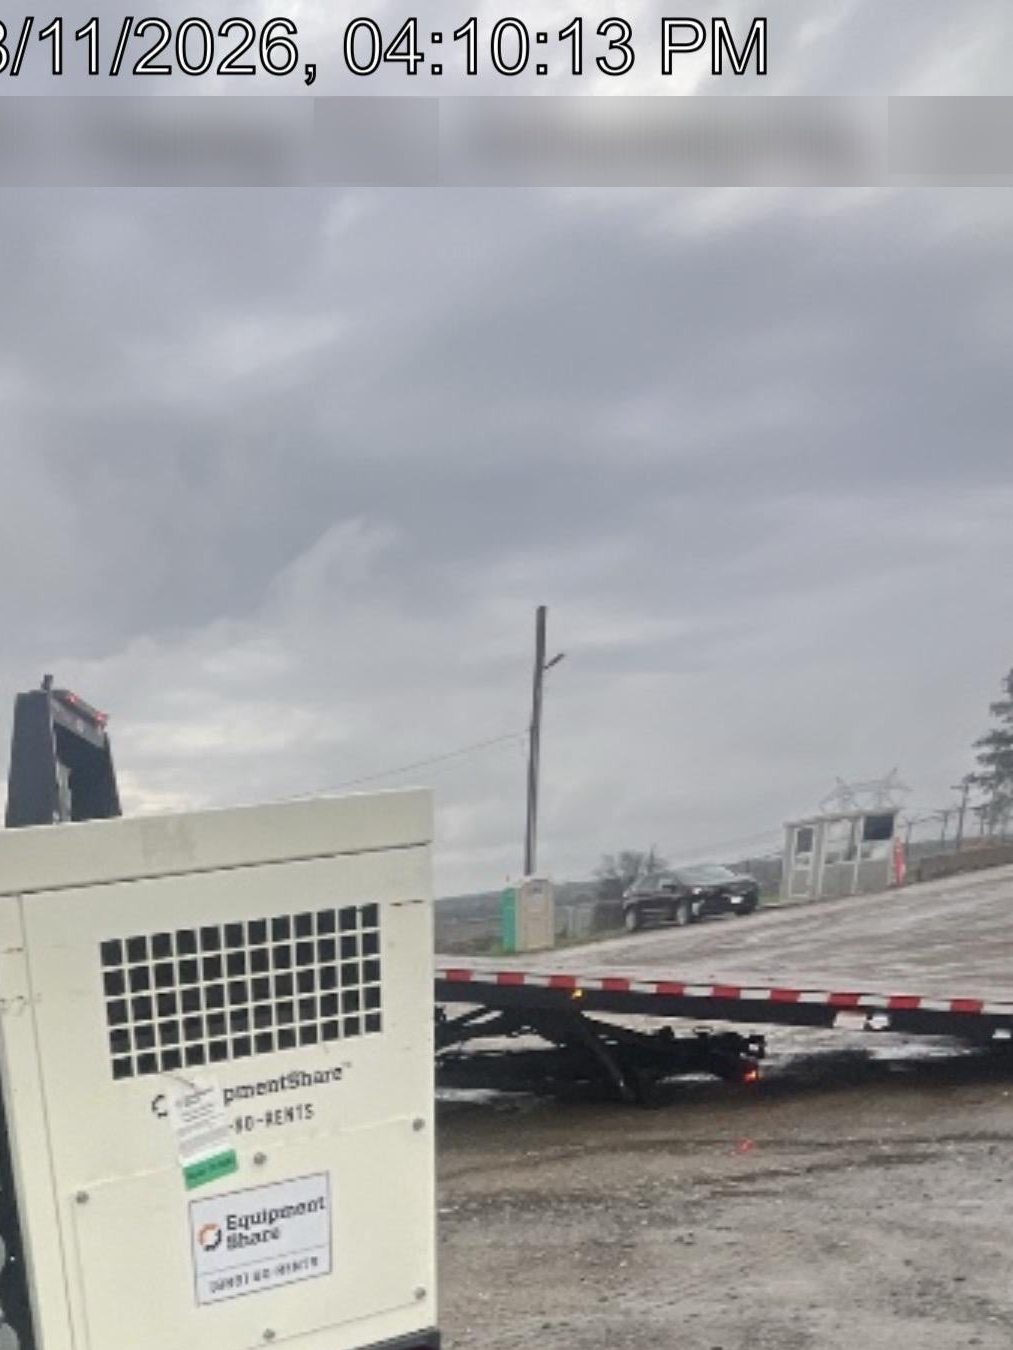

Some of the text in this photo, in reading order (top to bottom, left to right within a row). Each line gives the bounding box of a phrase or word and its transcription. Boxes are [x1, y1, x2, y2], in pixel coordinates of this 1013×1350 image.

[223, 1066, 343, 1107] pmentShare
[226, 1196, 325, 1231] Equipment
[226, 1226, 281, 1251] Share
